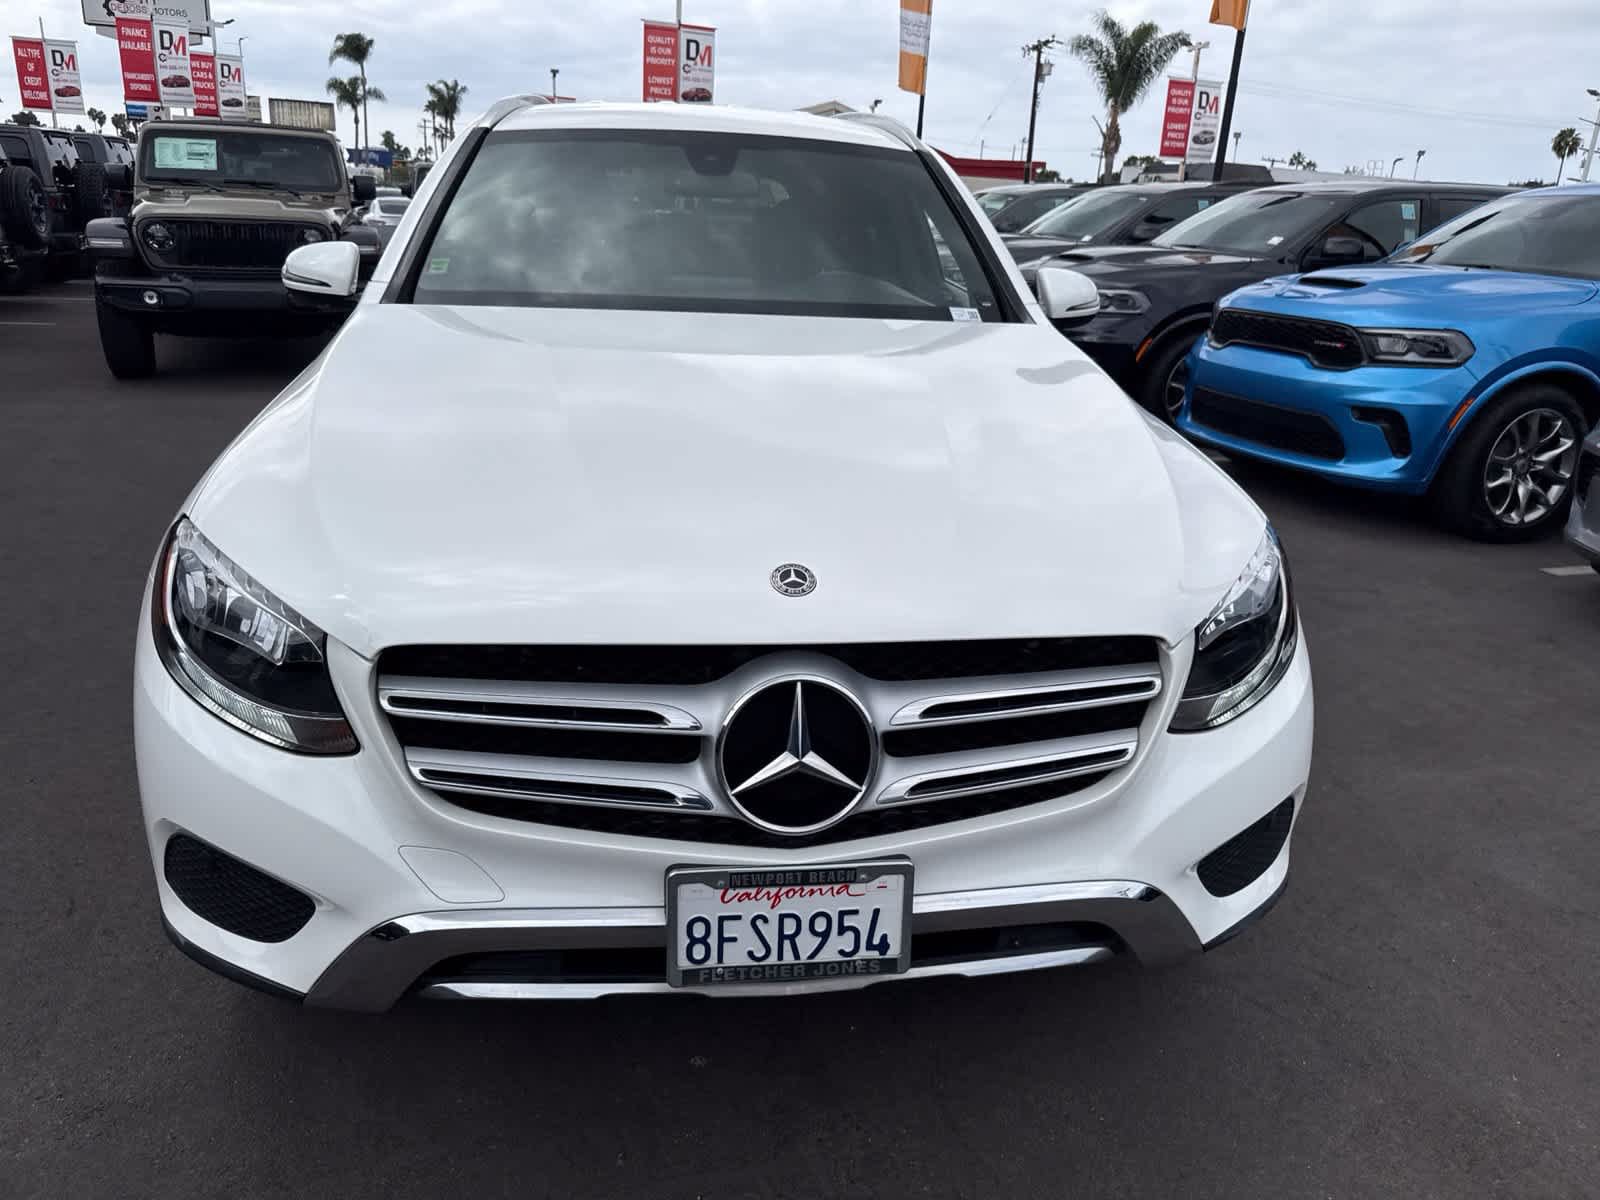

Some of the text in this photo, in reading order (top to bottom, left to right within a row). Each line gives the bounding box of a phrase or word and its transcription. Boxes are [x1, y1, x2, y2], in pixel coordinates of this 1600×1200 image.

[121, 26, 148, 38] FINANCE
[647, 34, 675, 45] QUALITY
[120, 41, 152, 51] AVAILABLE
[650, 46, 672, 56] IS OUR
[18, 48, 41, 59] ALL TYPE
[200, 61, 213, 69] BUY
[646, 55, 676, 66] PRIORITY
[27, 62, 35, 71] OF
[192, 71, 208, 79] CARS
[24, 76, 42, 87] CREDIT
[193, 80, 215, 90] TRUCKS
[648, 75, 674, 86] LOWEST
[23, 90, 48, 101] WELCOME
[650, 86, 673, 96] PRICES
[1170, 88, 1192, 97] QUALITY
[1167, 106, 1190, 114] PRIORITY
[1166, 122, 1188, 131] LOWEST
[1168, 130, 1185, 139] PRICES
[731, 869, 857, 886] NEWPORT BEACH
[719, 883, 865, 910] California
[685, 906, 892, 965] 8FSR954
[699, 959, 882, 982] FLETCHER JONES
